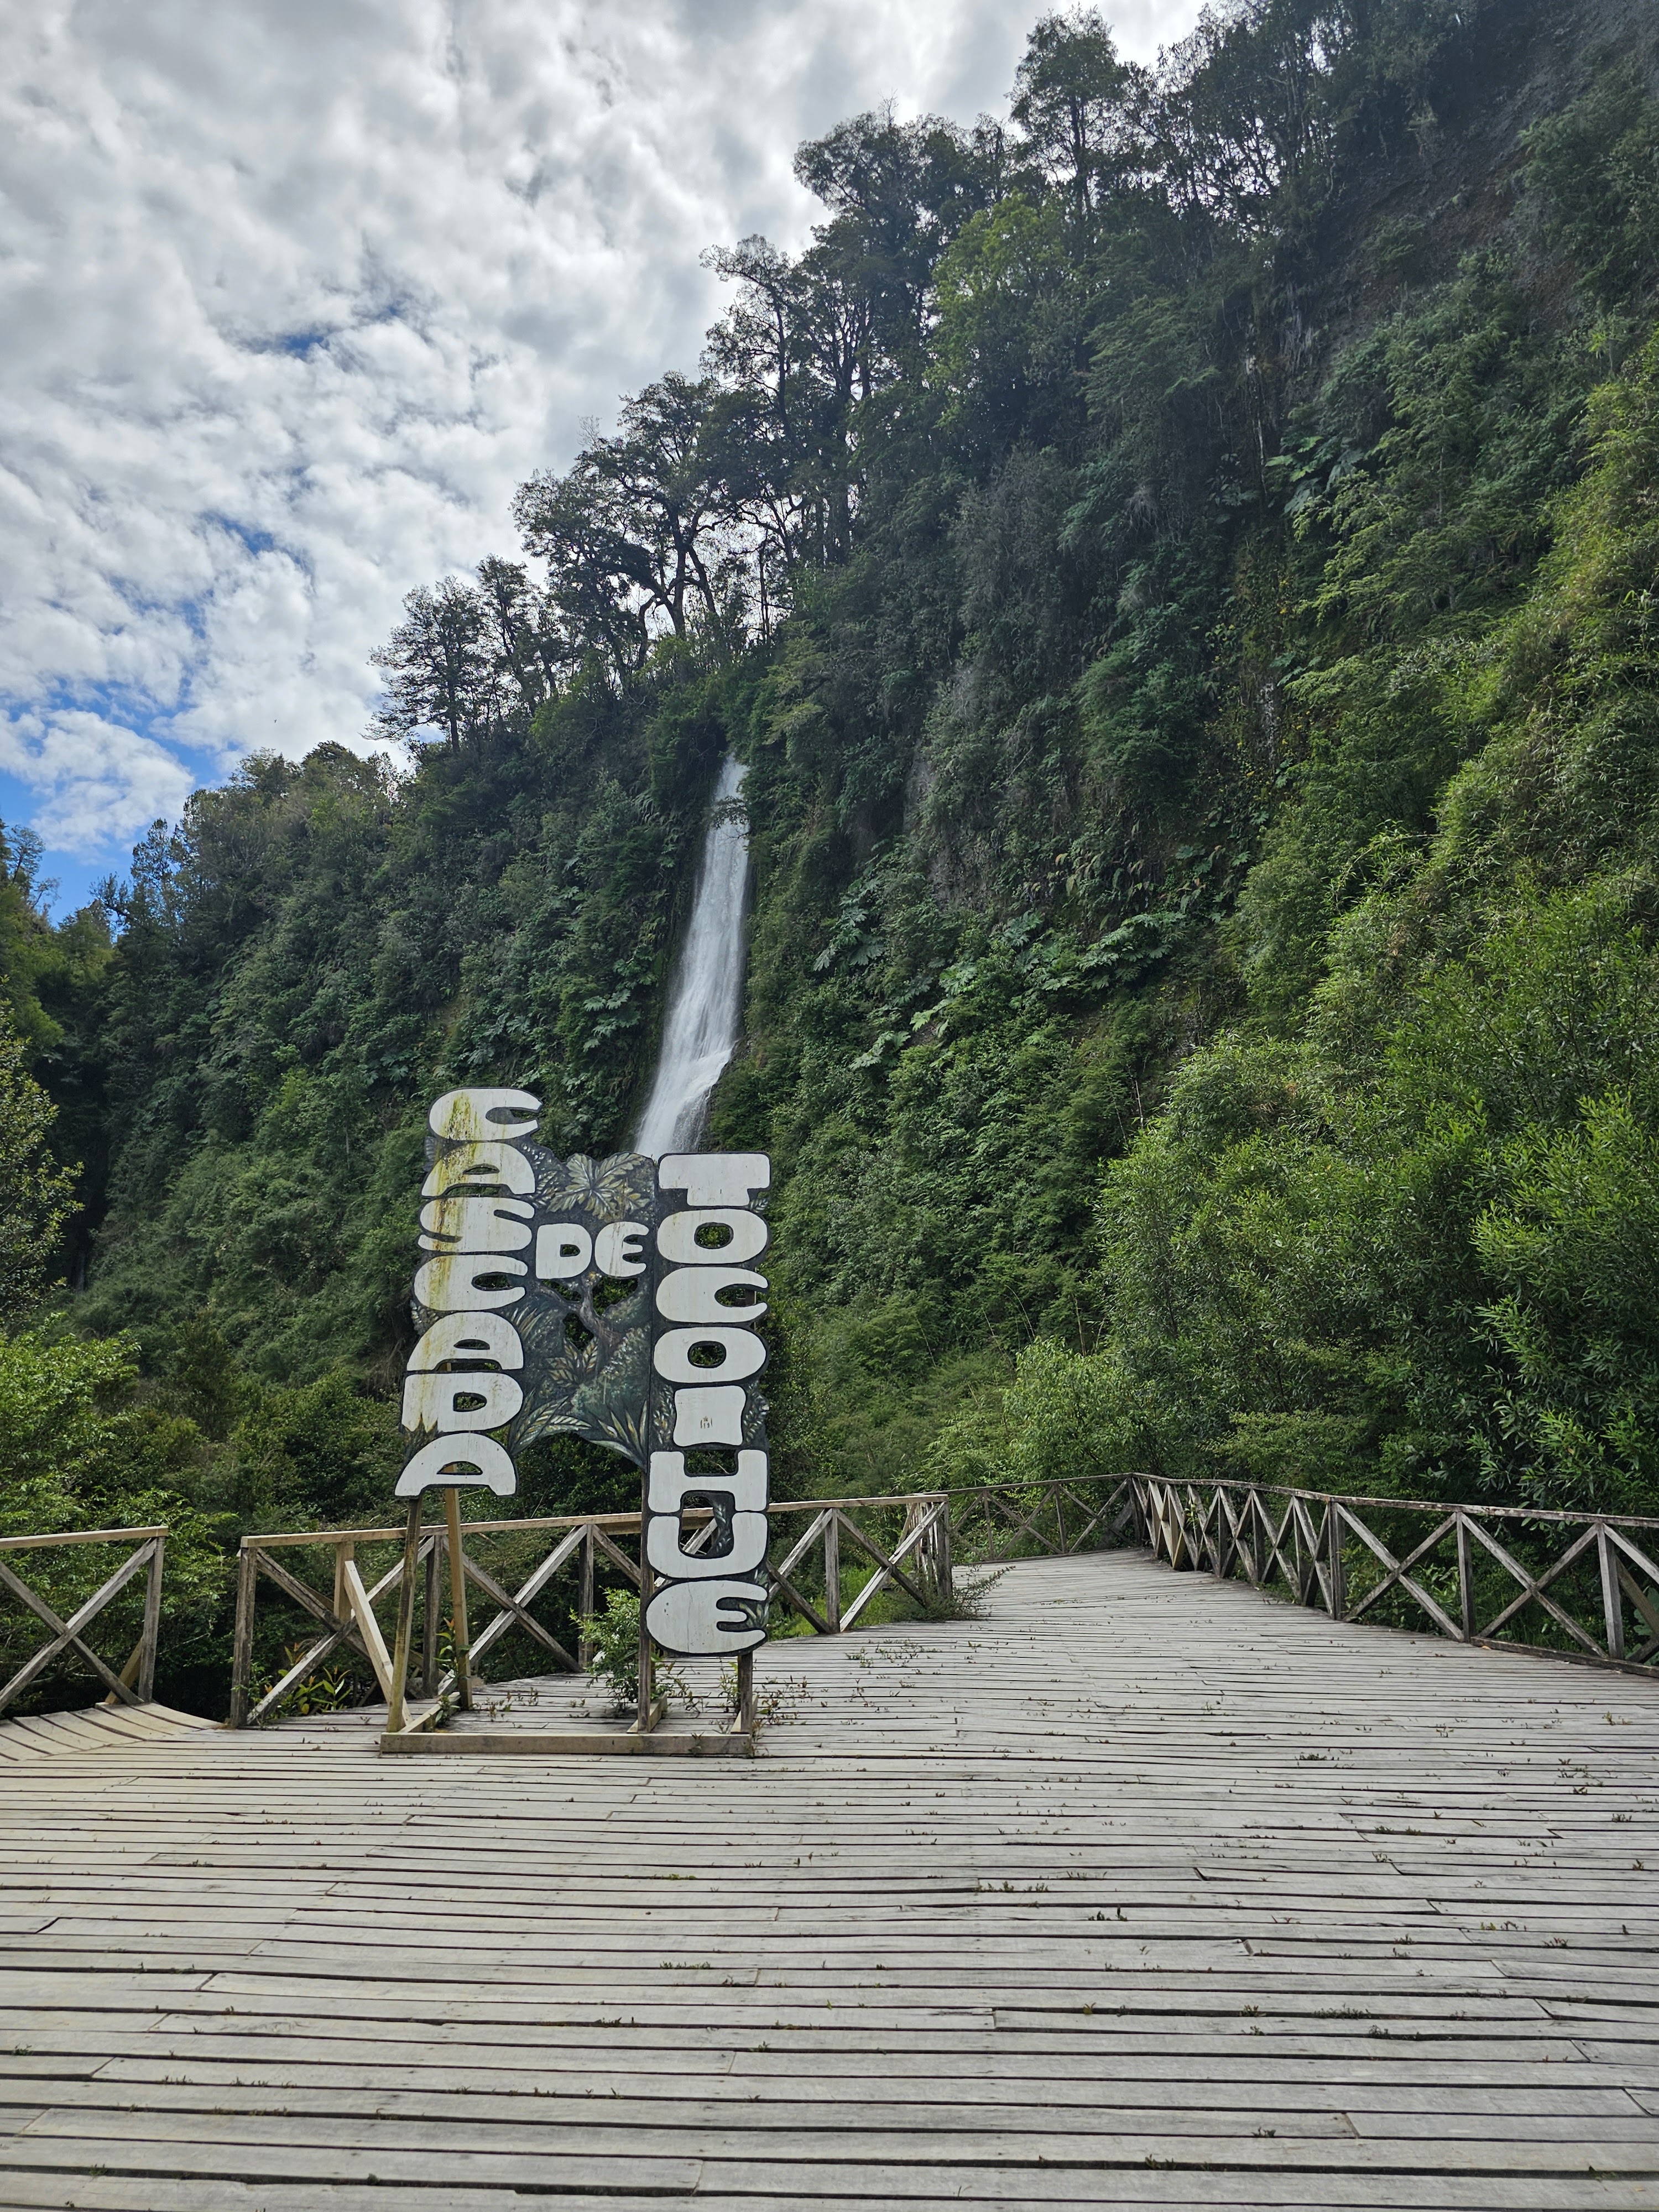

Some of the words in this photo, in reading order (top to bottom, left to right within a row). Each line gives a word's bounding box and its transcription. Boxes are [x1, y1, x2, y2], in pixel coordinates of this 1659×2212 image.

[395, 1088, 542, 1496] CASCADA
[536, 1223, 649, 1279] DE
[646, 1154, 770, 1653] TOCOIHUE
